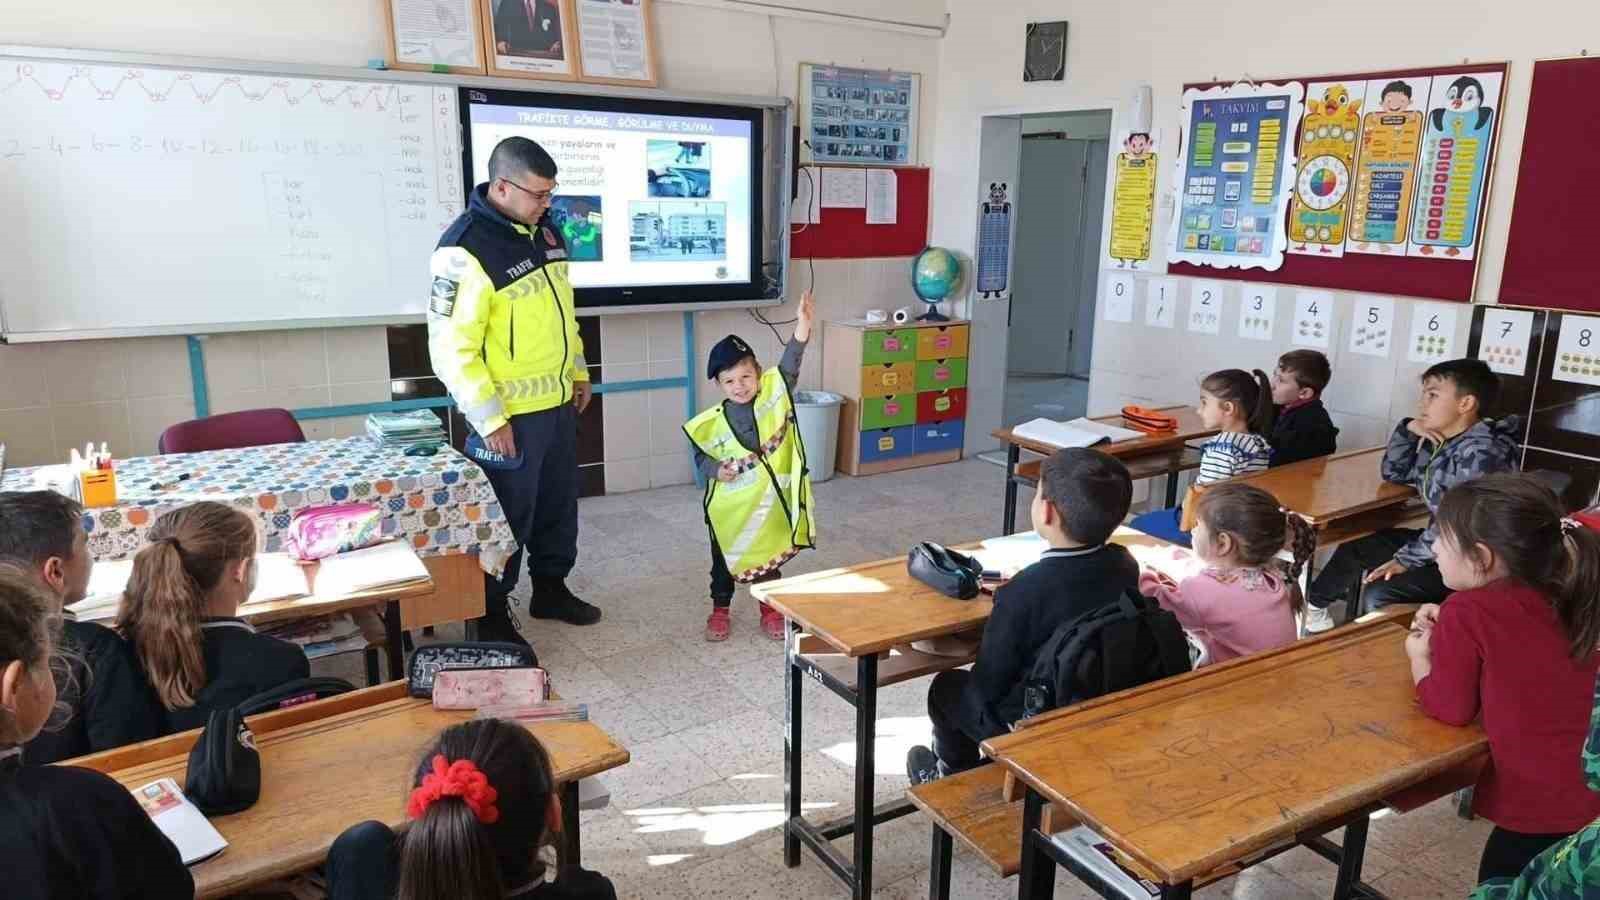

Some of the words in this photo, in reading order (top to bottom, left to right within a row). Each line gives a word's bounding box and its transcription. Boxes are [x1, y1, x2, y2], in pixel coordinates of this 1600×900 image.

[1115, 282, 1124, 297] 0
[1159, 287, 1165, 300] 1
[1202, 290, 1212, 305] 2
[1254, 295, 1263, 310] 3
[1308, 301, 1319, 317] 4
[1367, 307, 1379, 324] 5
[1428, 314, 1439, 331] 6
[1500, 321, 1513, 339] 7
[1578, 328, 1592, 347] 8
